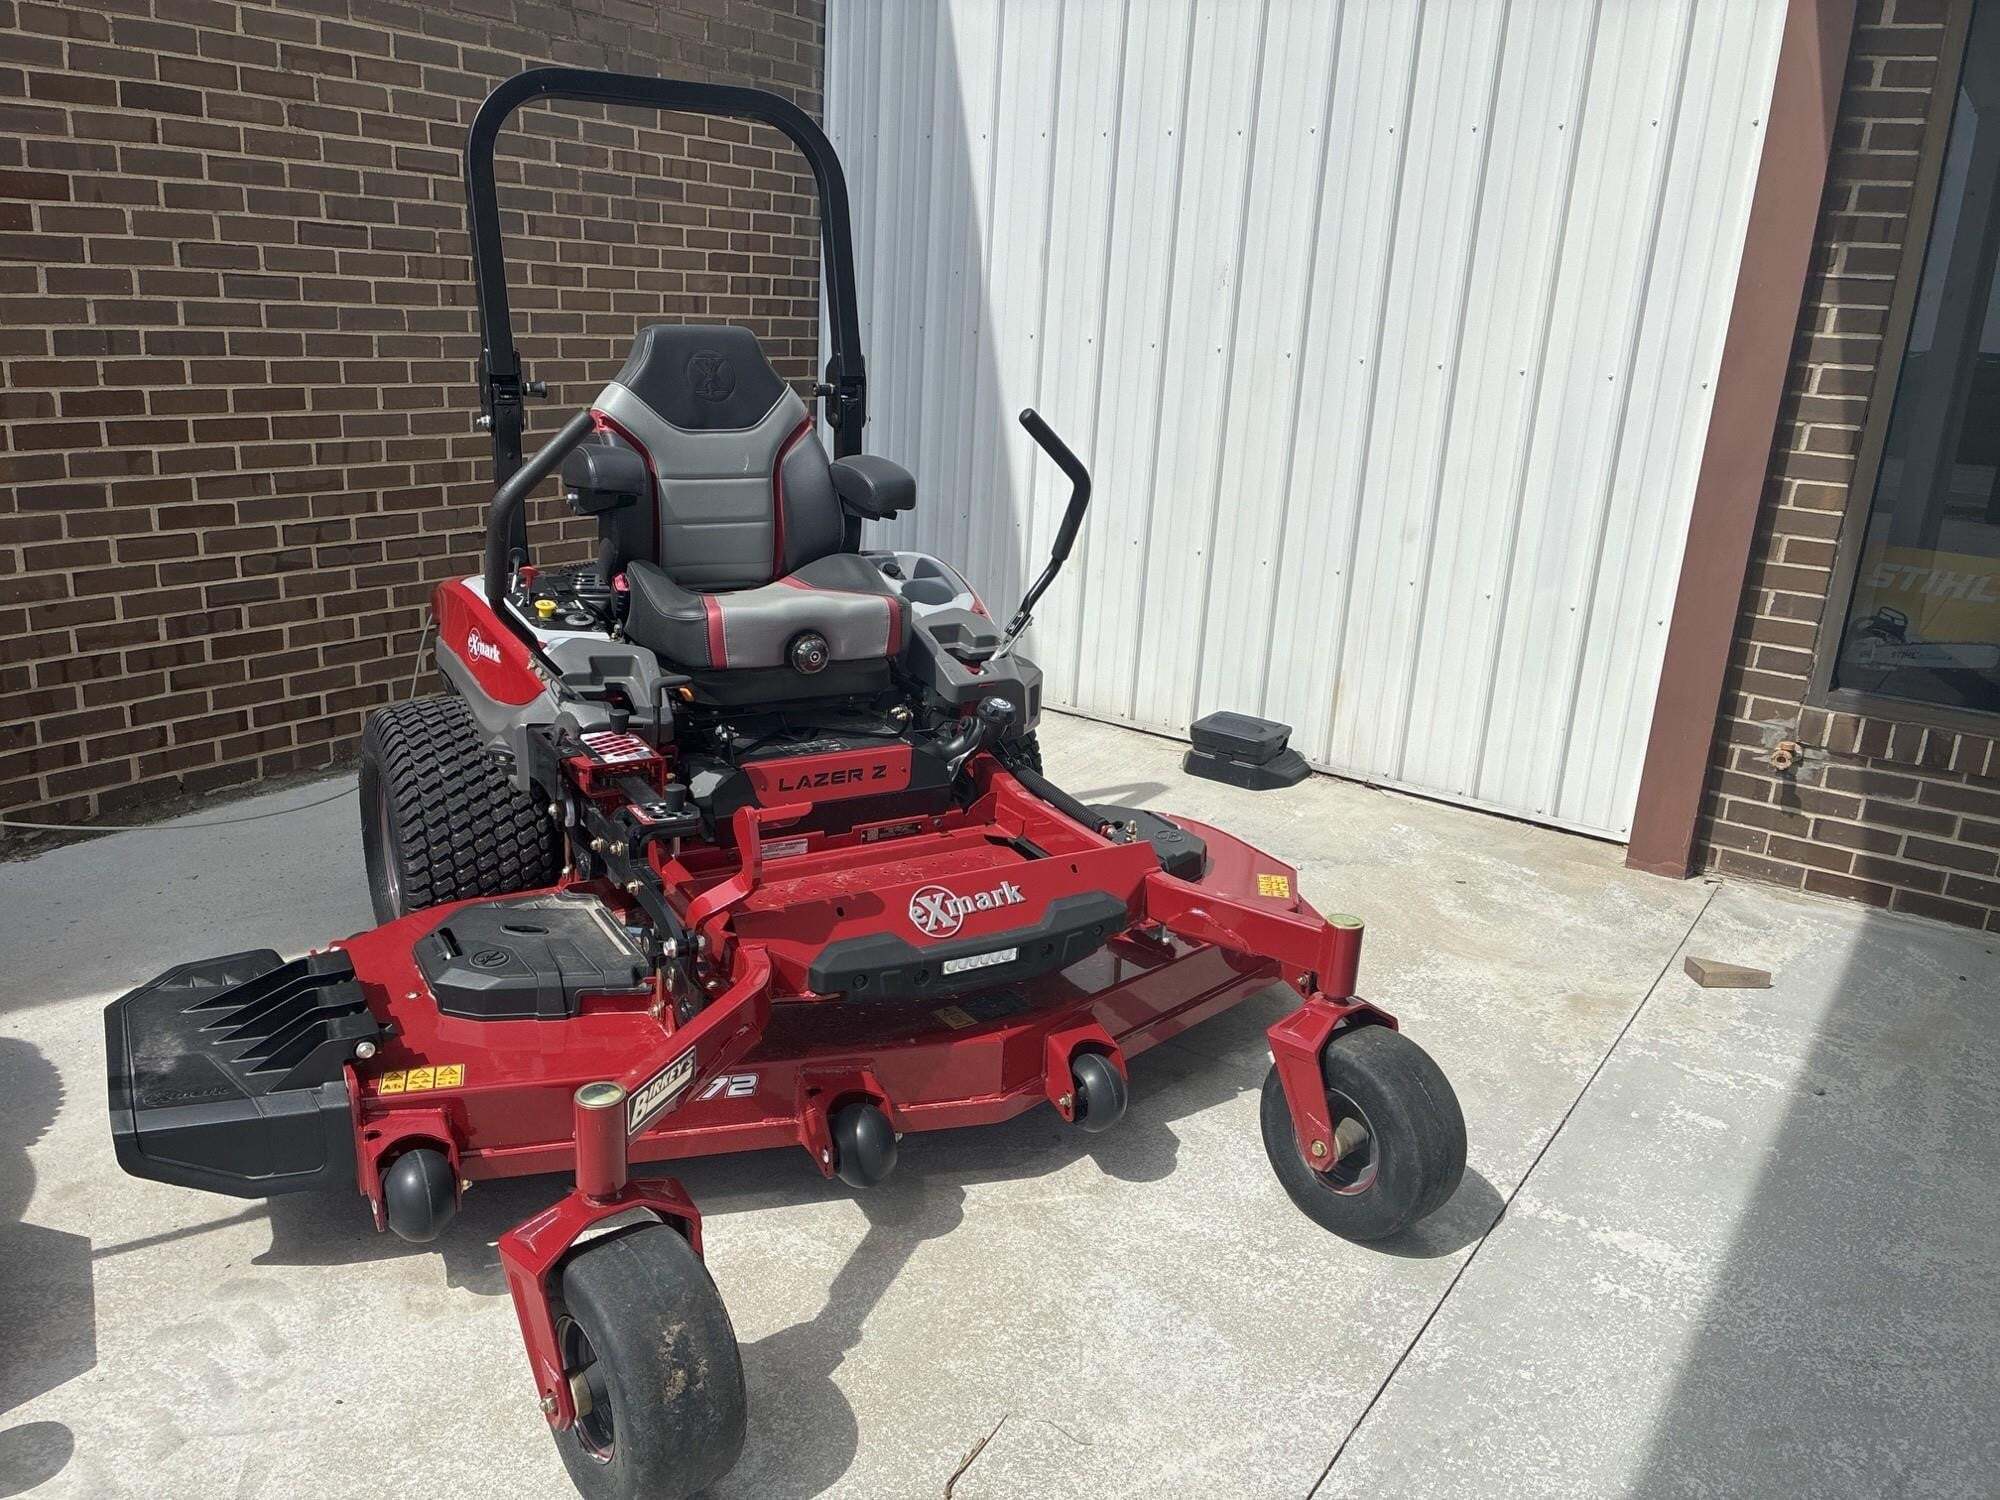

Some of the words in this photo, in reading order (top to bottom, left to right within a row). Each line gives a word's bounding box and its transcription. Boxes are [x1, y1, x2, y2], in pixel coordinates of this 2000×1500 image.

[1871, 563, 1996, 603] STIHL
[779, 768, 864, 793] LAZER
[871, 764, 888, 780] Z
[909, 881, 1026, 935] eXmark
[698, 1073, 758, 1100] 72
